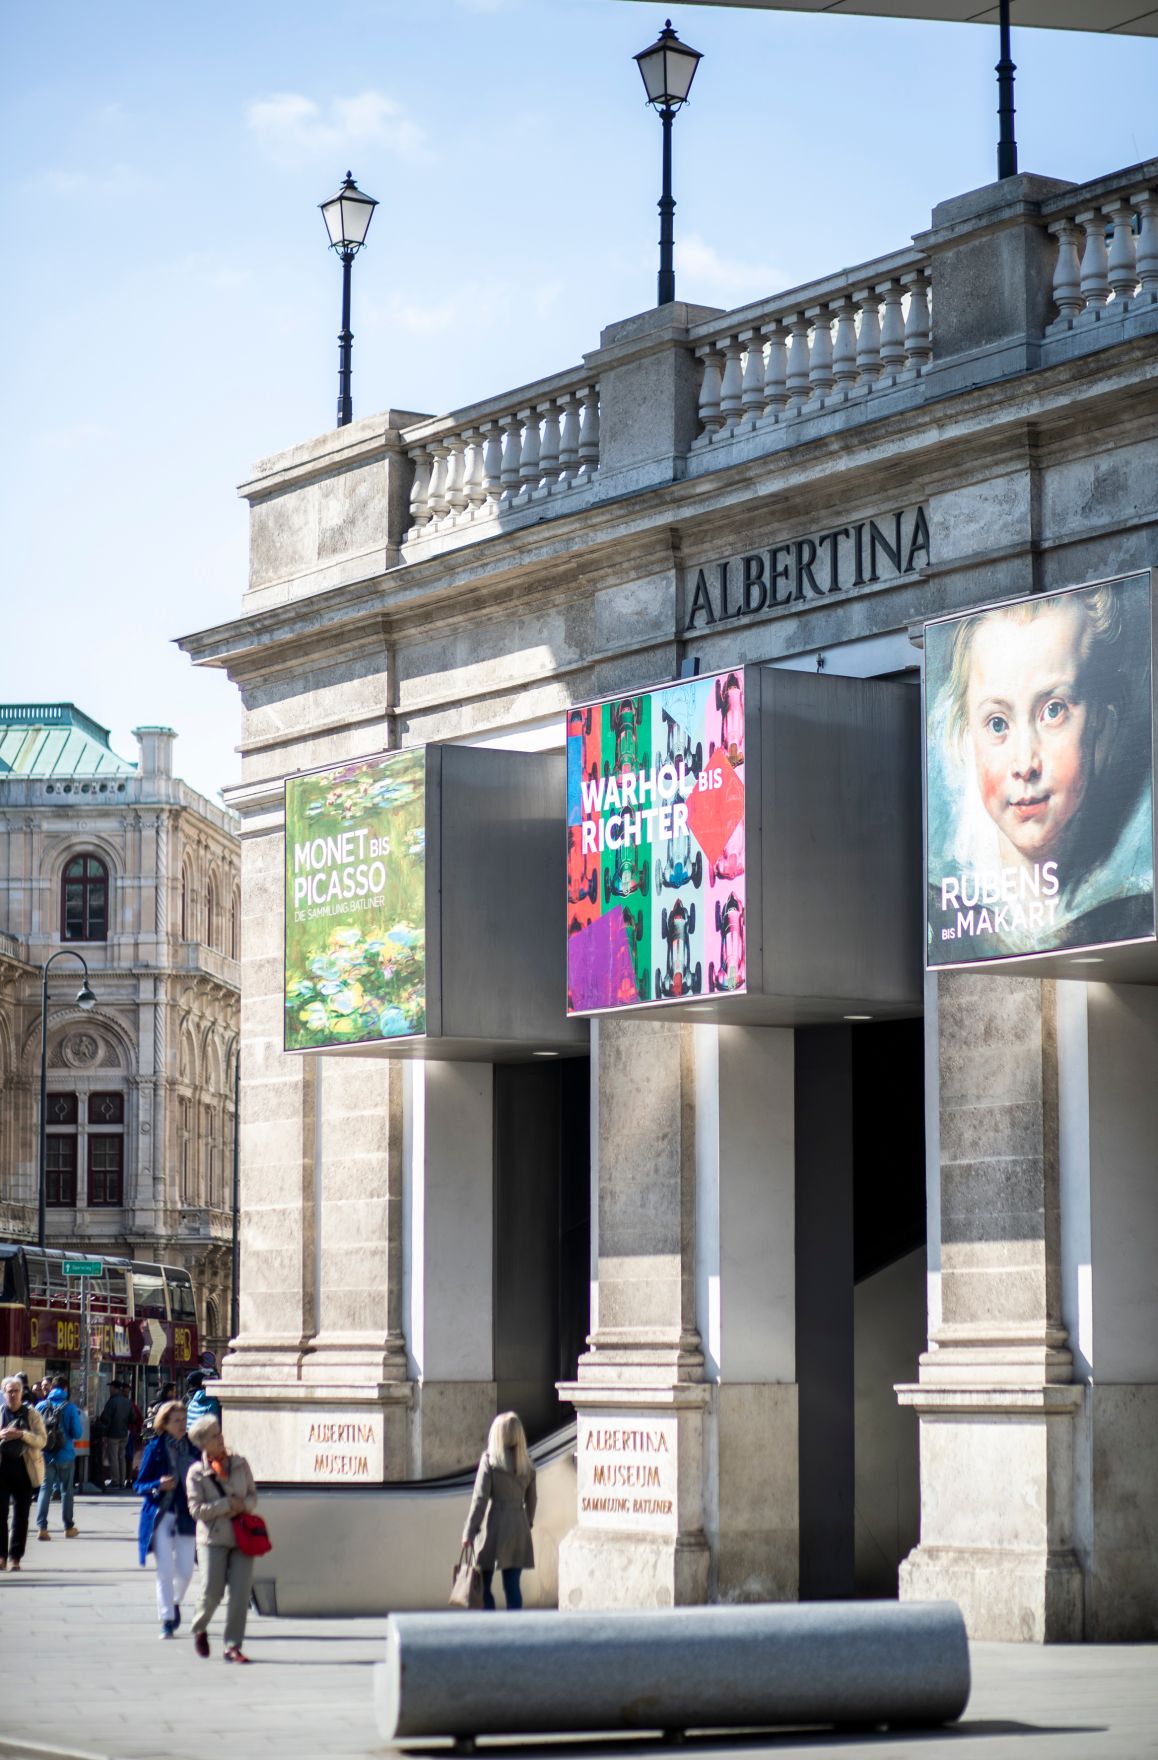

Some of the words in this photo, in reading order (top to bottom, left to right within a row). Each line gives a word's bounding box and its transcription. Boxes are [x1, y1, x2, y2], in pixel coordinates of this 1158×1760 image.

[686, 505, 930, 631] ALBERTINA
[581, 761, 694, 814] WARHOL
[698, 768, 723, 792] BIS
[294, 828, 368, 873] MONET
[370, 836, 390, 858] BIS
[581, 803, 690, 855] RICHTER
[294, 861, 386, 908] PICASSO
[941, 861, 1059, 911] RUBENS
[294, 910, 307, 923] DIE
[308, 902, 349, 920] SAMMLUNG
[350, 896, 385, 912] BATLINER
[941, 928, 955, 940] BIS
[957, 898, 1059, 938] MAKART
[308, 1423, 376, 1443] ALBERTINA
[585, 1430, 669, 1453] ALBERTINA
[314, 1454, 369, 1476] MUSEUM
[593, 1464, 661, 1488] MUSEUM
